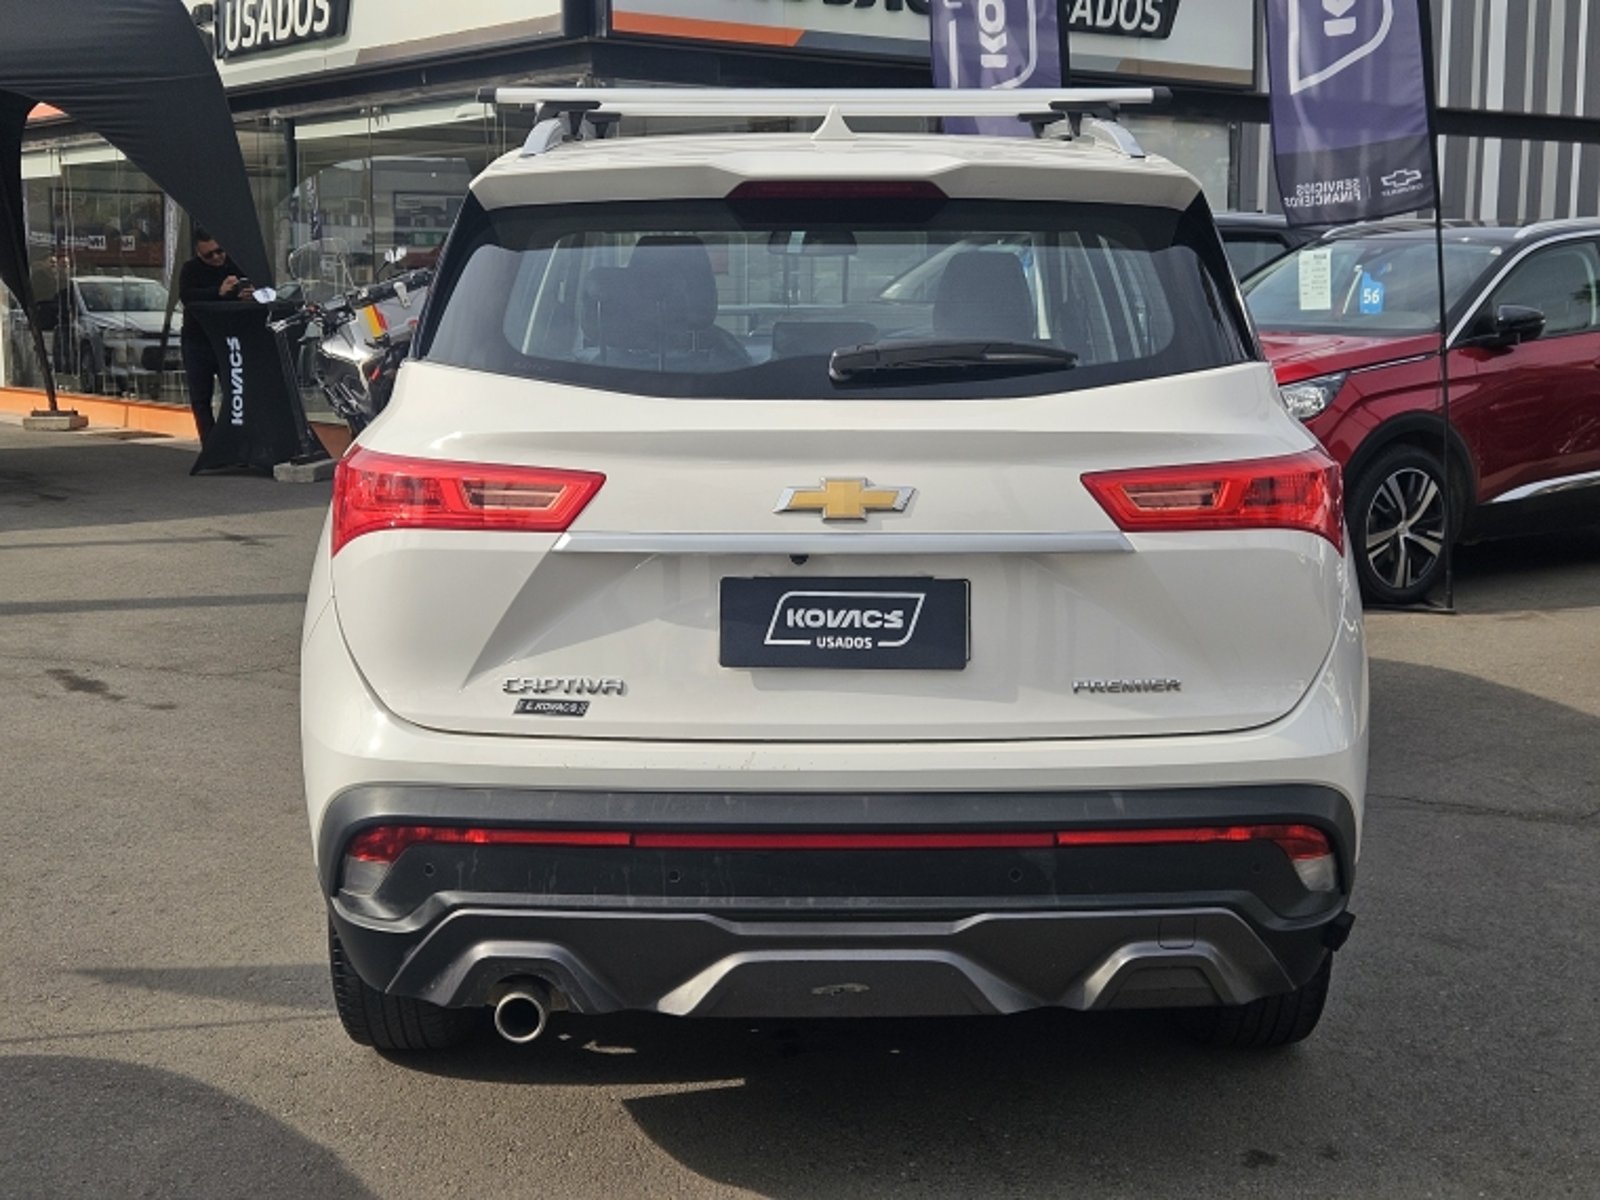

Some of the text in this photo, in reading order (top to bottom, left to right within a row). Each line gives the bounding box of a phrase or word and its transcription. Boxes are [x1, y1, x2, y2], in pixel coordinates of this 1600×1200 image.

[225, 0, 330, 51] USADOS
[1067, 0, 1161, 33] ADOS
[1363, 287, 1380, 304] 56
[226, 336, 243, 426] KOVACS
[786, 608, 904, 628] KOVACS
[816, 636, 873, 649] USADOS
[502, 678, 626, 697] CAPTIVA
[1072, 678, 1182, 694] PREMIER
